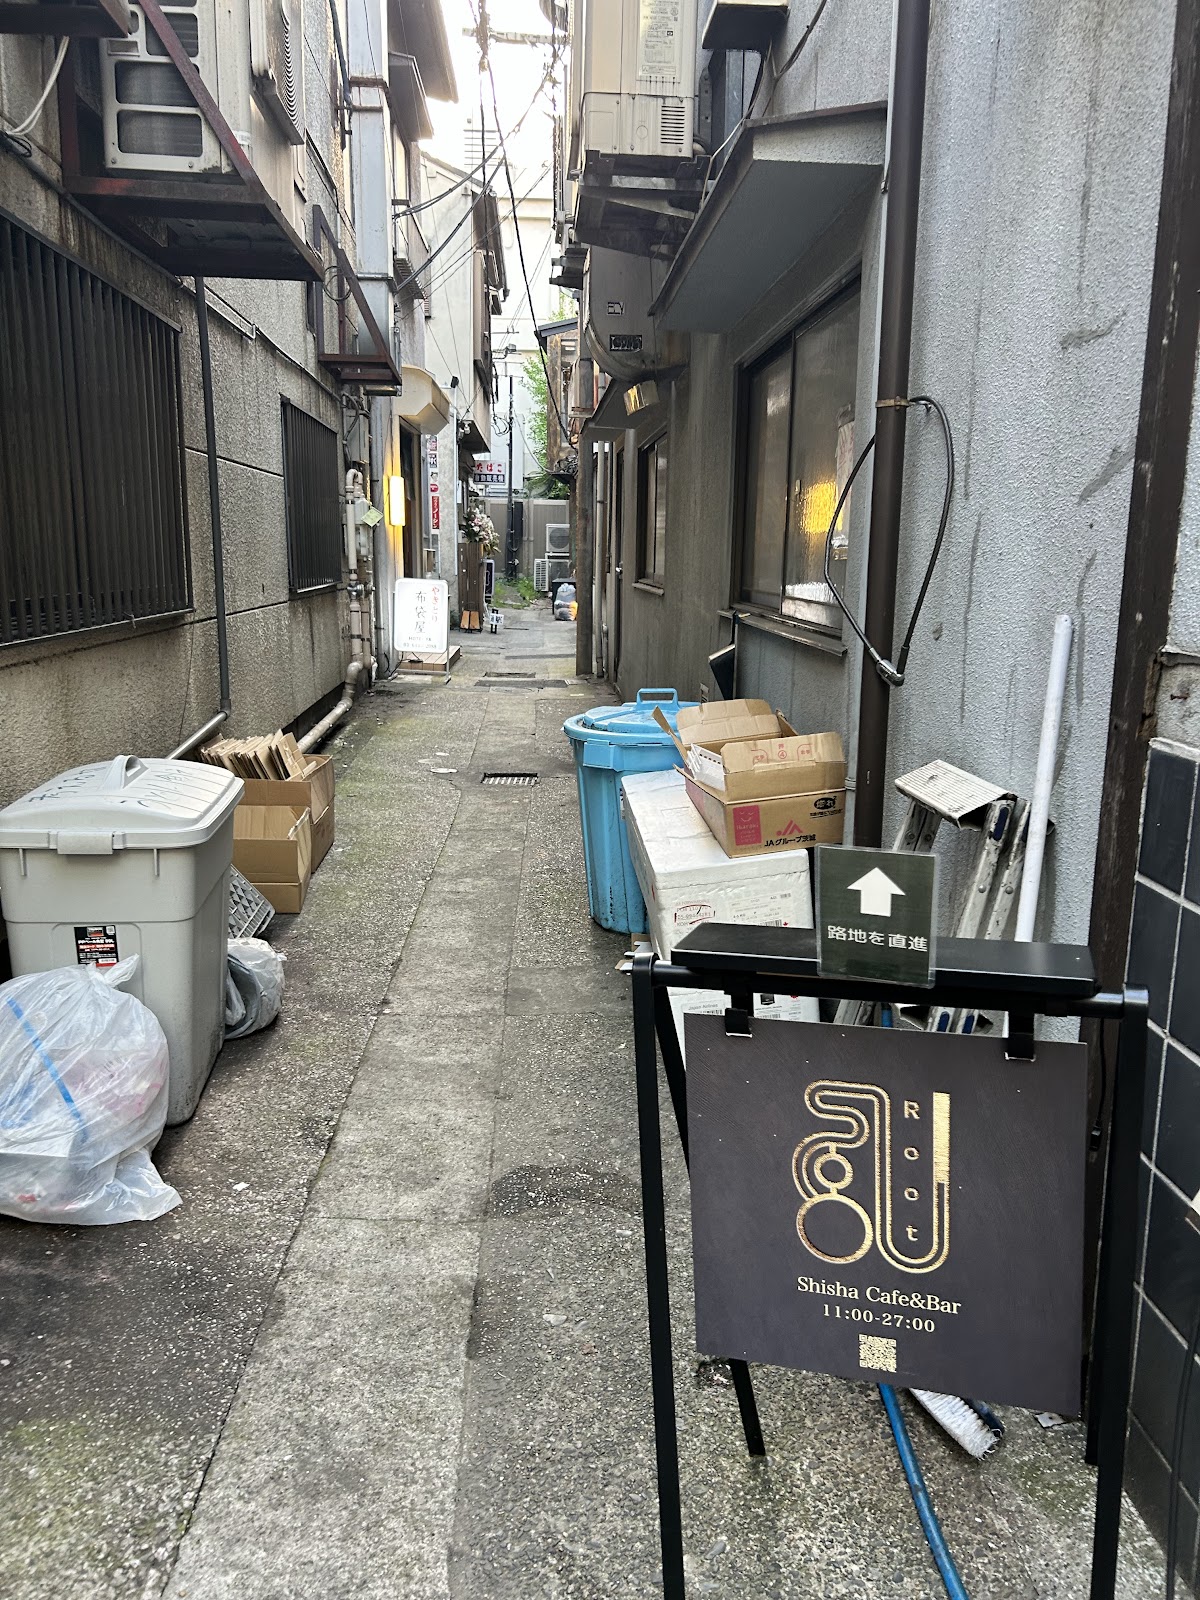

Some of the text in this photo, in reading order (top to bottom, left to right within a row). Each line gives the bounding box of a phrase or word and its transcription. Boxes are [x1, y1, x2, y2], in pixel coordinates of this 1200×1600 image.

[476, 462, 502, 473] たばこ
[415, 591, 427, 633] 布袋屋
[431, 586, 440, 622] やきとり
[827, 925, 928, 953] 路地を直進
[796, 1276, 962, 1315] Shisha Cafe&Bar
[822, 1303, 936, 1333] 11:00-27:00
